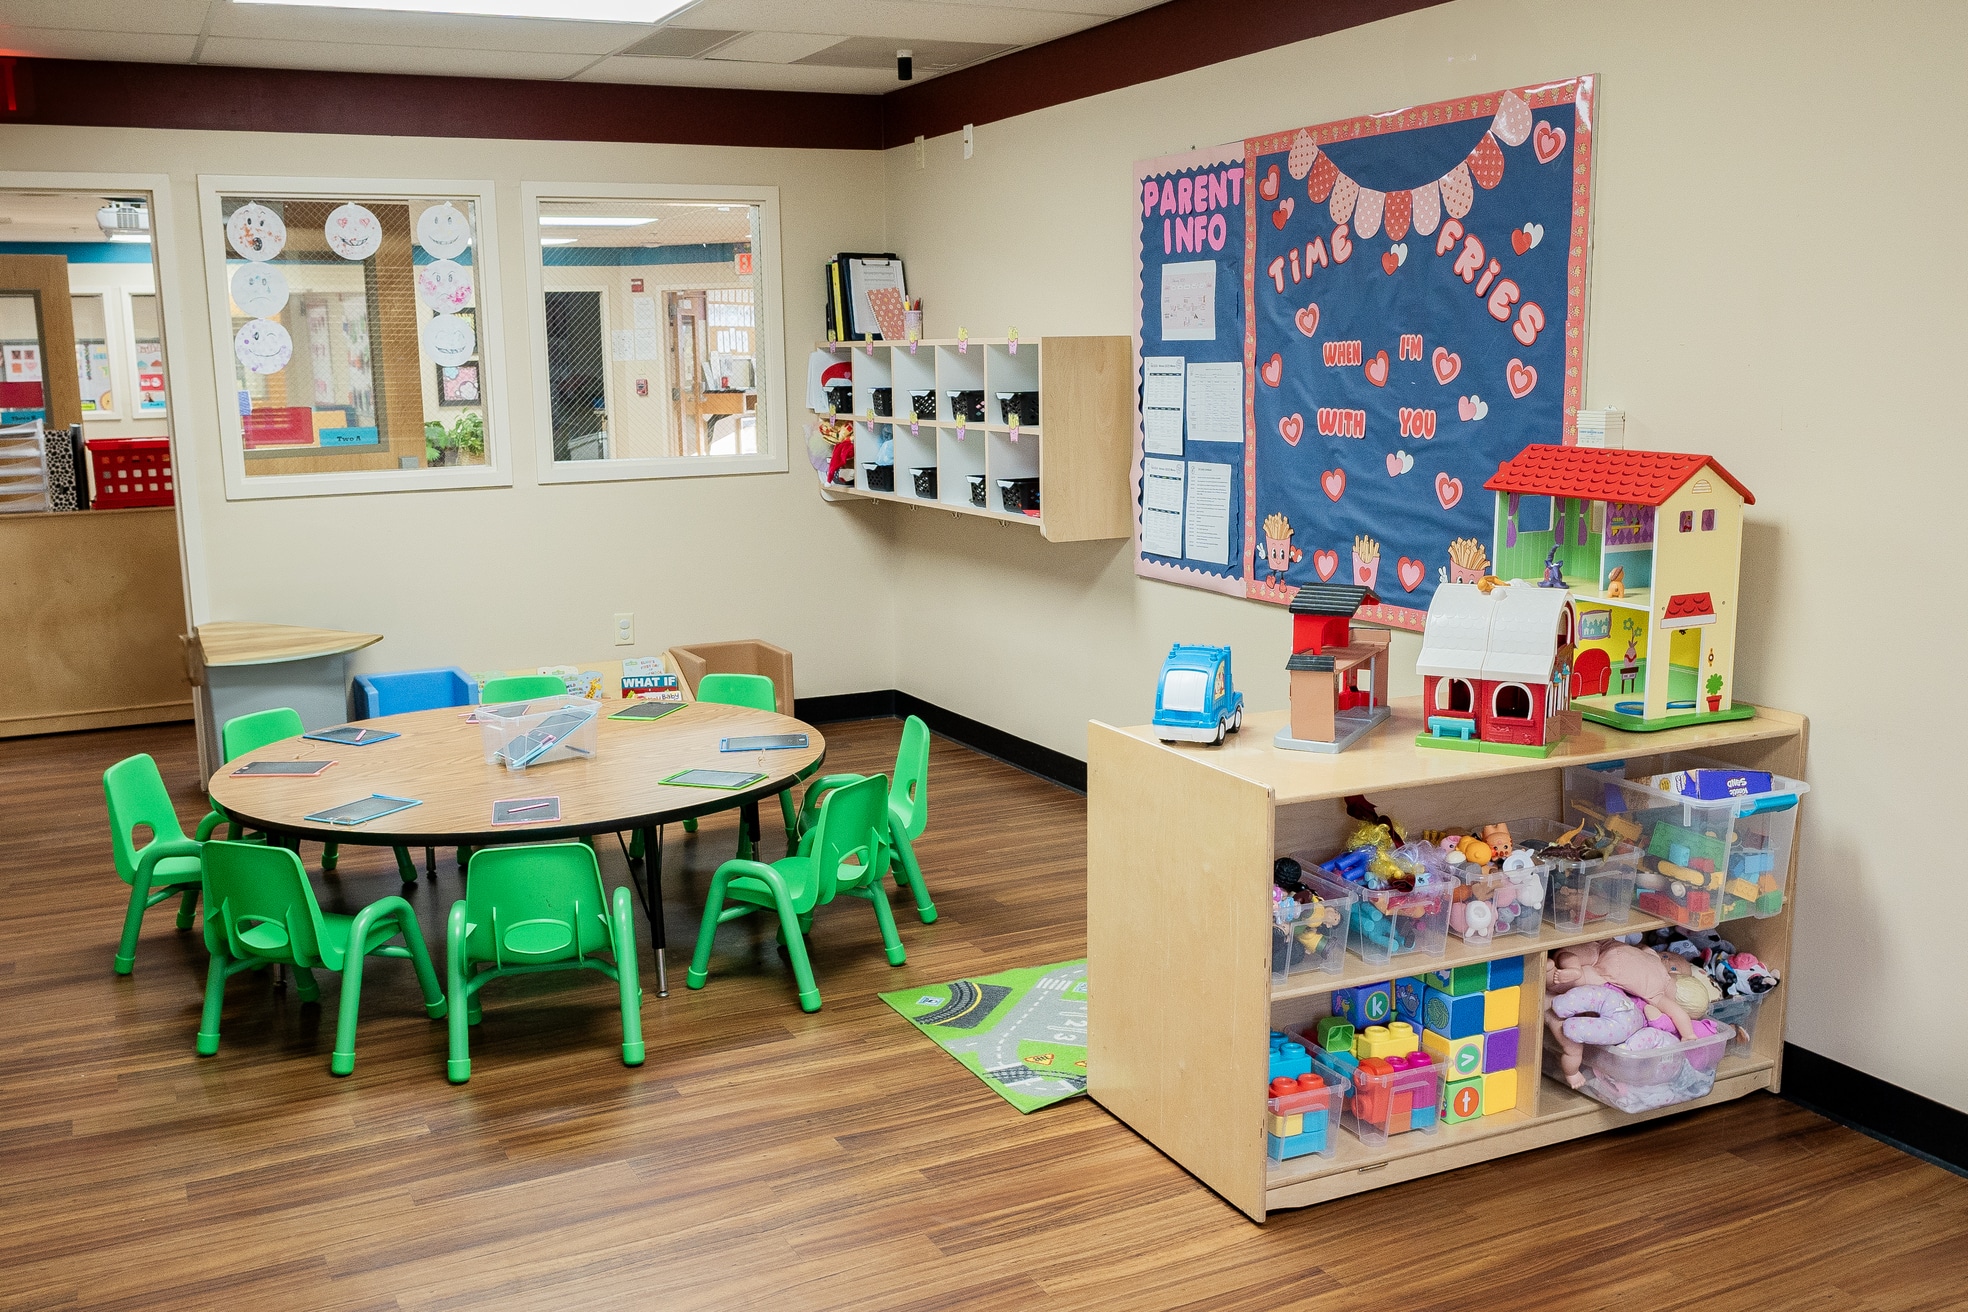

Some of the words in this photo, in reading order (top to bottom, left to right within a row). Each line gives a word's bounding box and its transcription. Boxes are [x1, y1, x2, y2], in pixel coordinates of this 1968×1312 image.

[1144, 168, 1244, 218] PARENT
[1163, 213, 1227, 254] INFO
[1268, 224, 1353, 294] TIME
[1435, 218, 1545, 346] FRIES
[1322, 340, 1362, 367] WHEN
[1317, 408, 1366, 439] WITH
[1399, 408, 1437, 440] YOU
[622, 677, 660, 688] WHAT
[663, 676, 675, 687] IF
